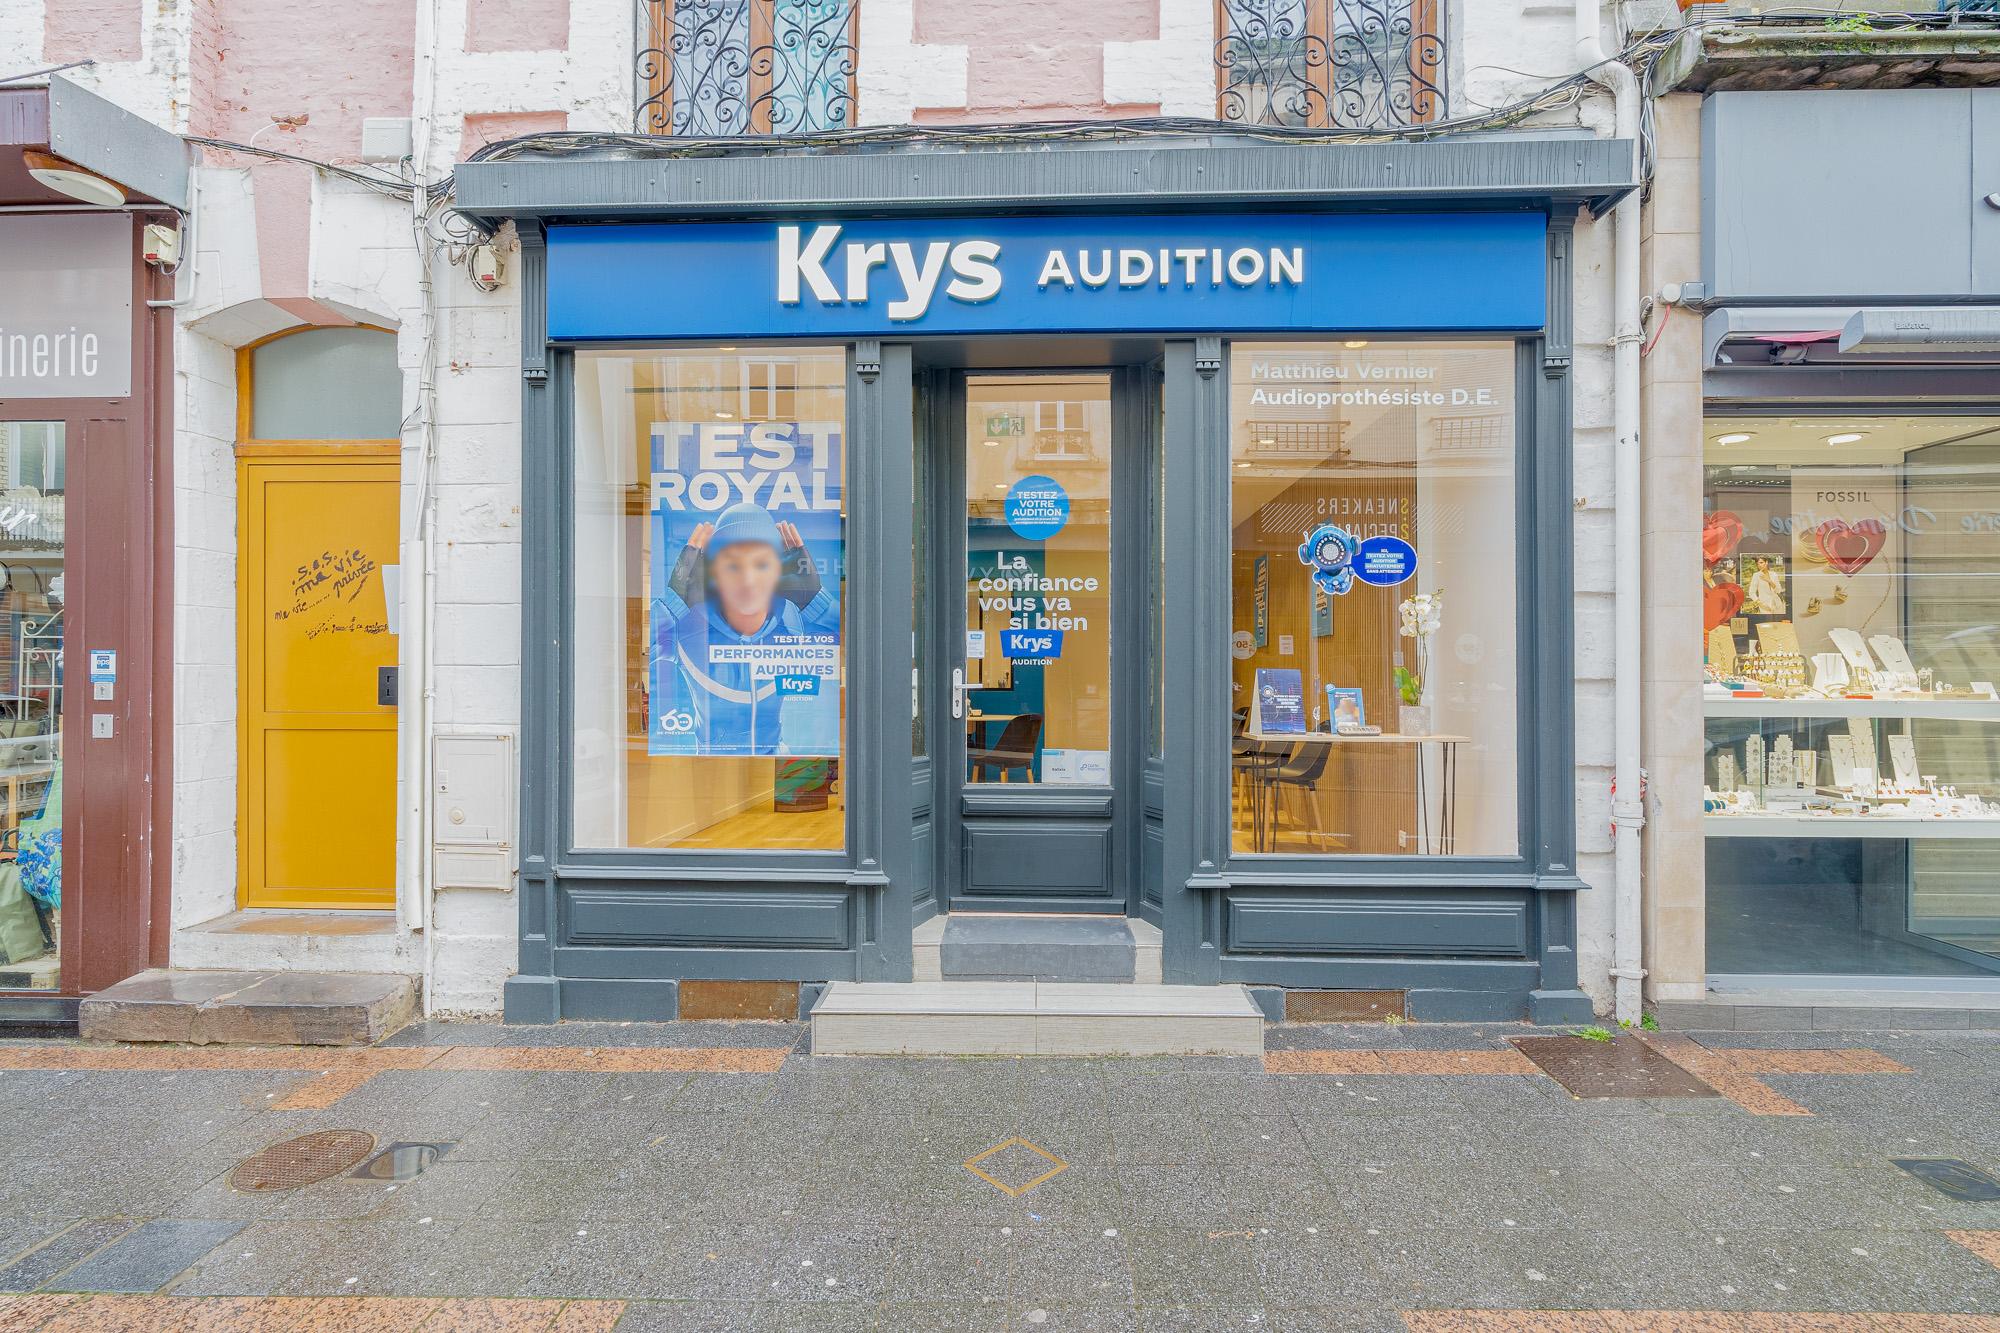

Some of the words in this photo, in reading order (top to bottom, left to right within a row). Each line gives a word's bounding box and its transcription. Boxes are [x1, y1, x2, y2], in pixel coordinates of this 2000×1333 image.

[778, 225, 1002, 321] Krys
[1038, 247, 1303, 288] AUDITION
[1251, 361, 1349, 379] Matthieu
[1355, 362, 1438, 379] Vernier
[1249, 388, 1445, 409] Audioprothésiste
[1451, 388, 1500, 406] D.E.
[650, 422, 842, 471] TEST
[650, 471, 842, 511] ROYAL
[1016, 491, 1058, 500] TESTEZ
[1816, 491, 1871, 503] FOSSIL
[1019, 500, 1055, 508] VOTRE
[1011, 508, 1062, 517] AUDITION
[997, 551, 1028, 570] La
[978, 573, 1099, 592] confiance
[978, 597, 1036, 612] vous
[1042, 597, 1072, 612] va
[1009, 613, 1029, 630] si
[1035, 613, 1088, 631] bien
[773, 635, 812, 643] TESTEZ
[813, 635, 834, 643] VOS
[1010, 634, 1052, 653] Krys
[713, 648, 834, 659] PERFORMANCES
[755, 665, 834, 675] AUDITIVES
[782, 678, 813, 692] Krys
